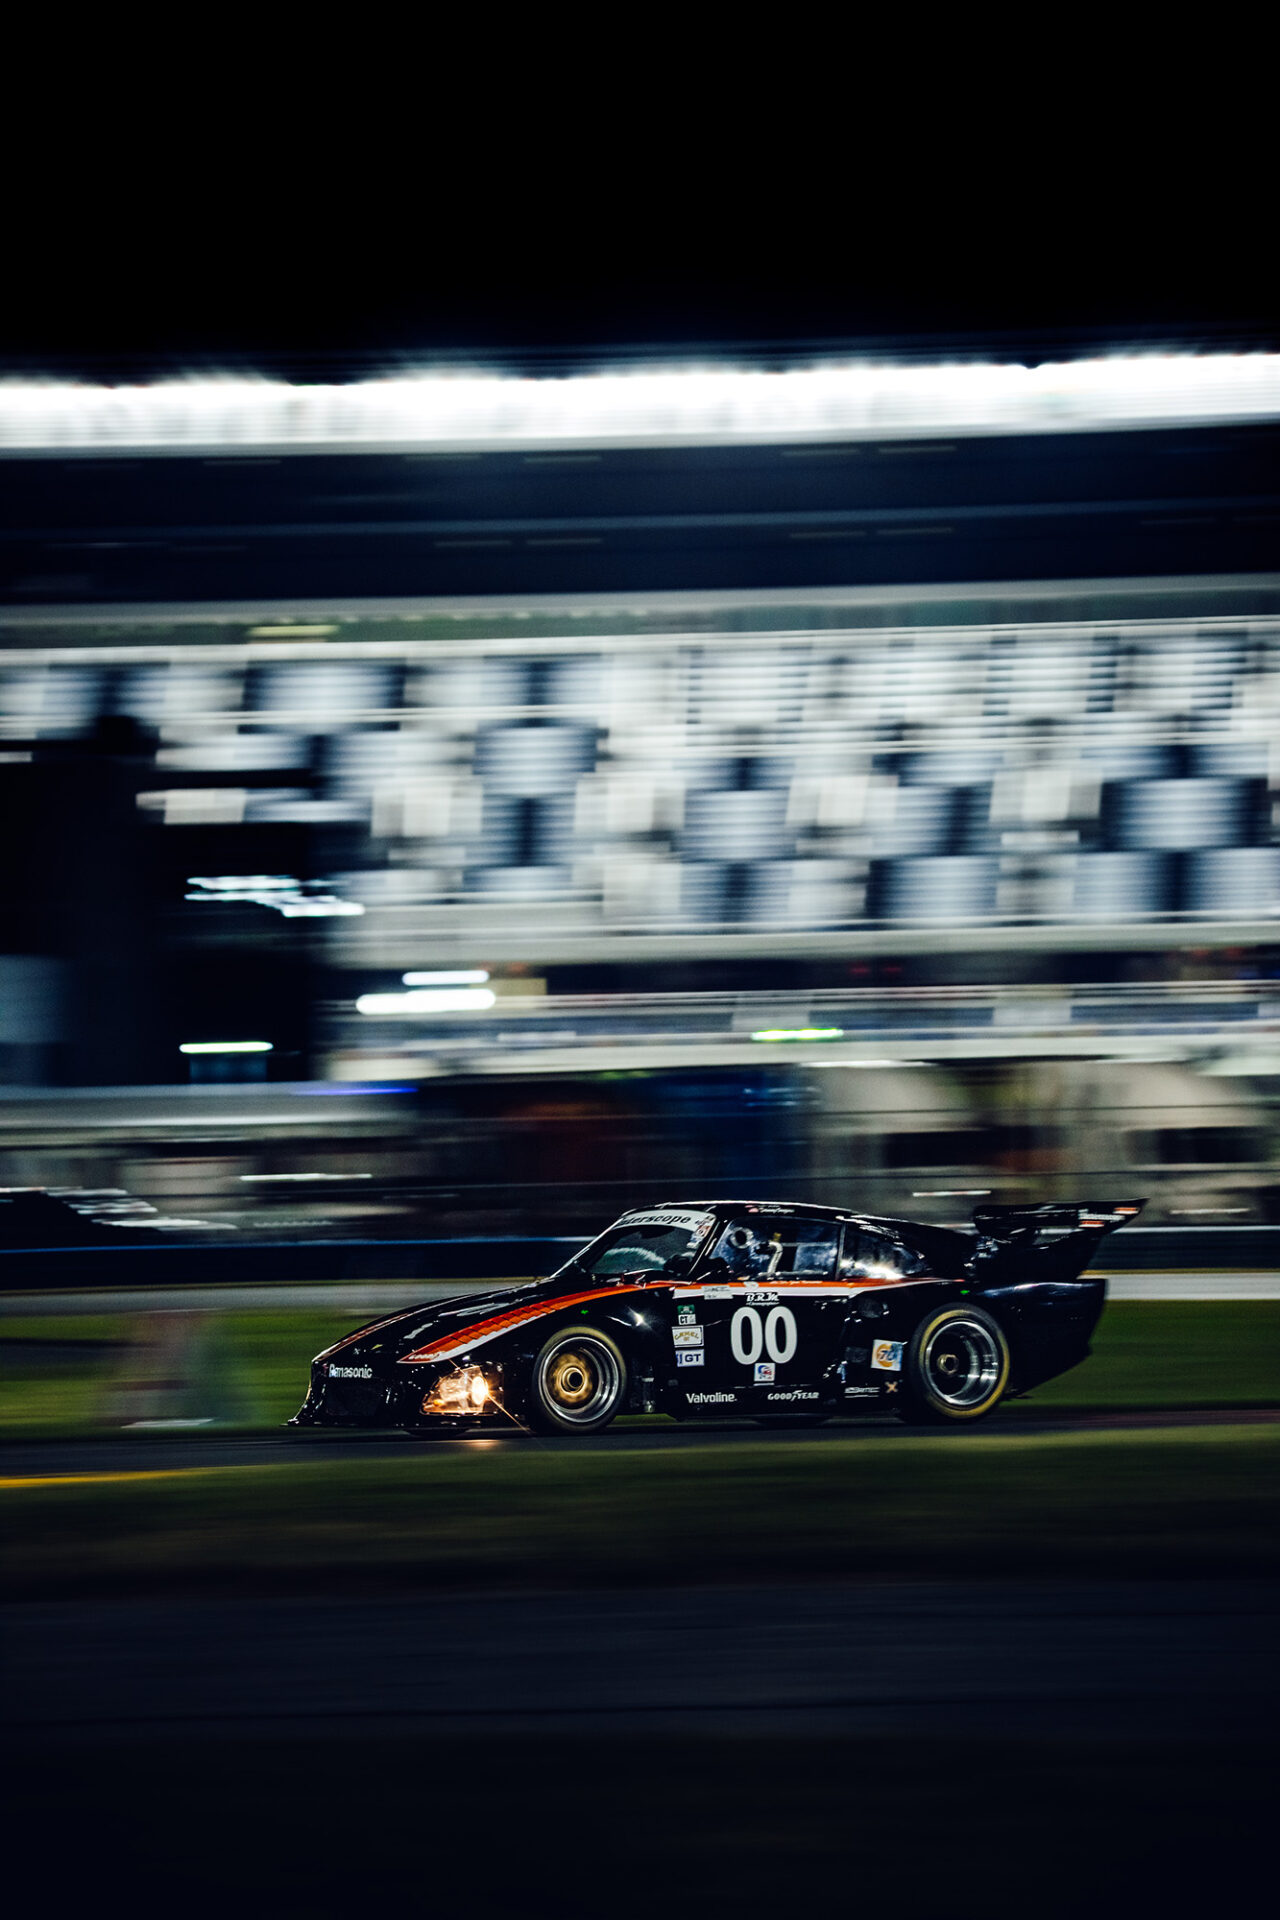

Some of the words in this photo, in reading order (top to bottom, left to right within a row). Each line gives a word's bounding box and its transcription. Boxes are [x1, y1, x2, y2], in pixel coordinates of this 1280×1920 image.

[730, 1306, 797, 1365] 00
[685, 1353, 702, 1362] GT
[686, 1392, 735, 1404] Valvoline
[767, 1390, 820, 1402] GOODYEAR
